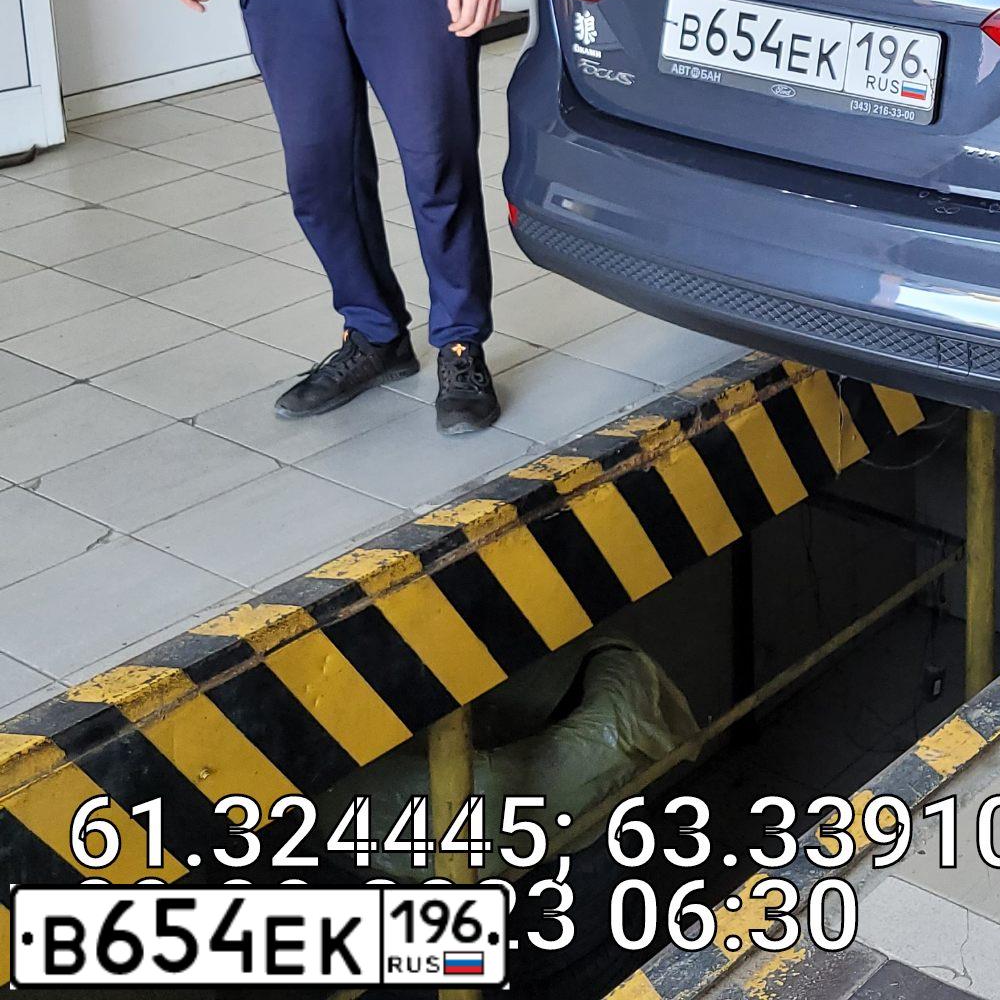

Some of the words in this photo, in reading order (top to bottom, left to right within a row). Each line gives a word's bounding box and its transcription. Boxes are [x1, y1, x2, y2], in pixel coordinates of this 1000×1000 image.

[678, 8, 842, 81] В654ЕК
[856, 31, 922, 79] 196
[865, 74, 900, 95] RUS
[850, 99, 872, 115] (343)
[872, 104, 916, 121] 216-33-00
